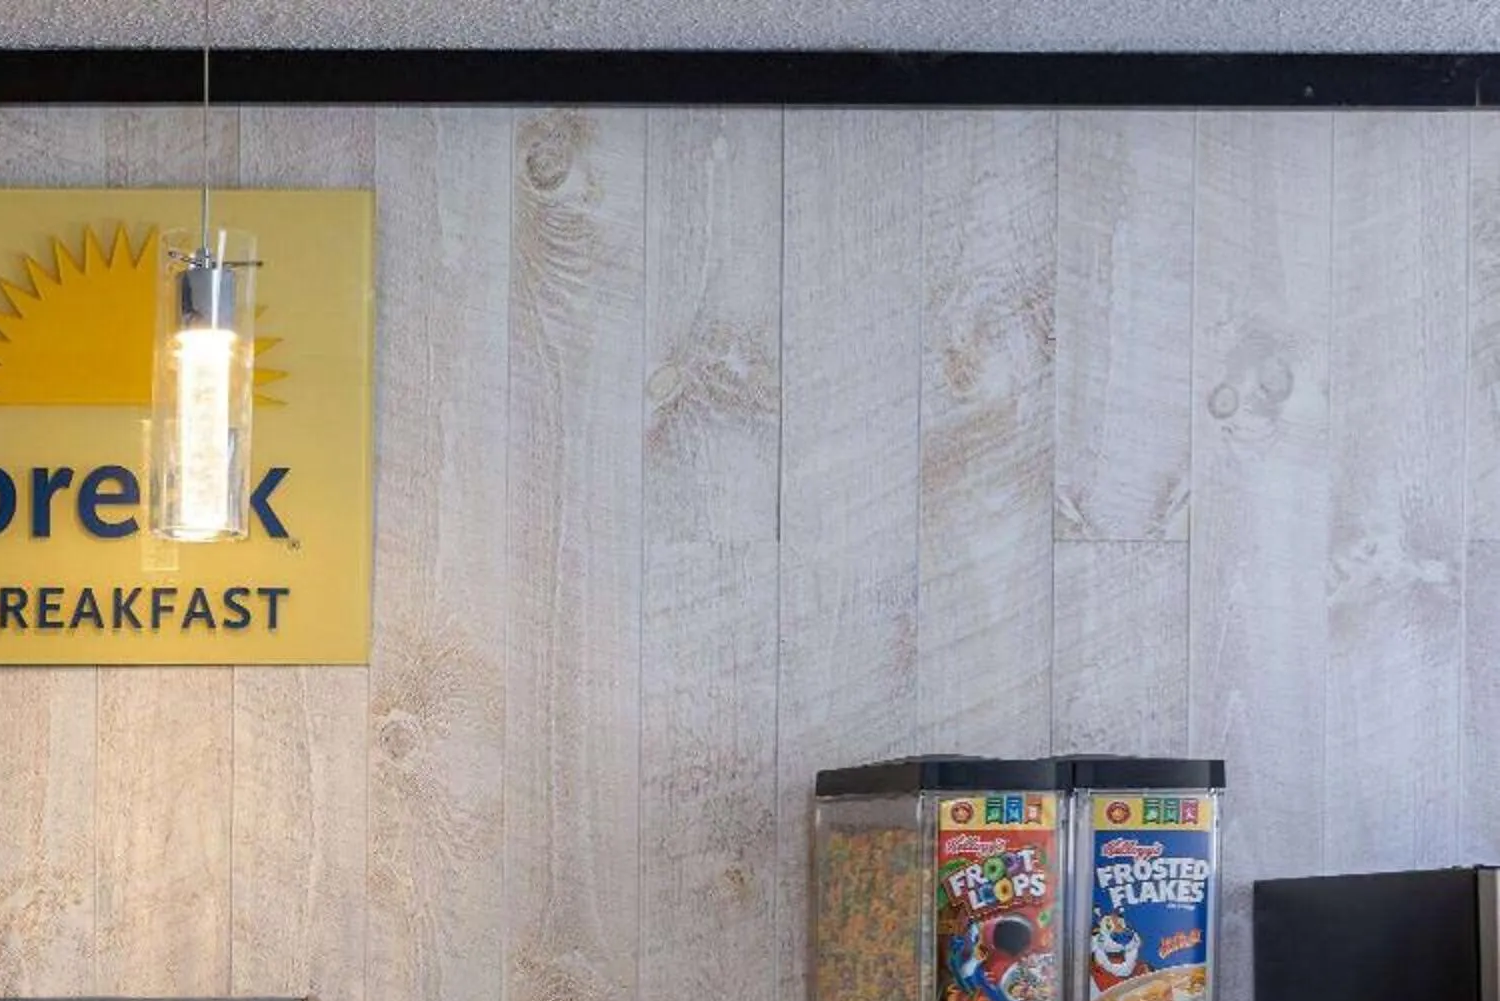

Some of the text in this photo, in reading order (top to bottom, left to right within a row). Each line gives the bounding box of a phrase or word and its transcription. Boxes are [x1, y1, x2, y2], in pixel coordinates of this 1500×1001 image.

[1096, 857, 1209, 888] FROSTED
[968, 873, 1046, 910] LOOPS
[1109, 879, 1204, 909] FLAKES
